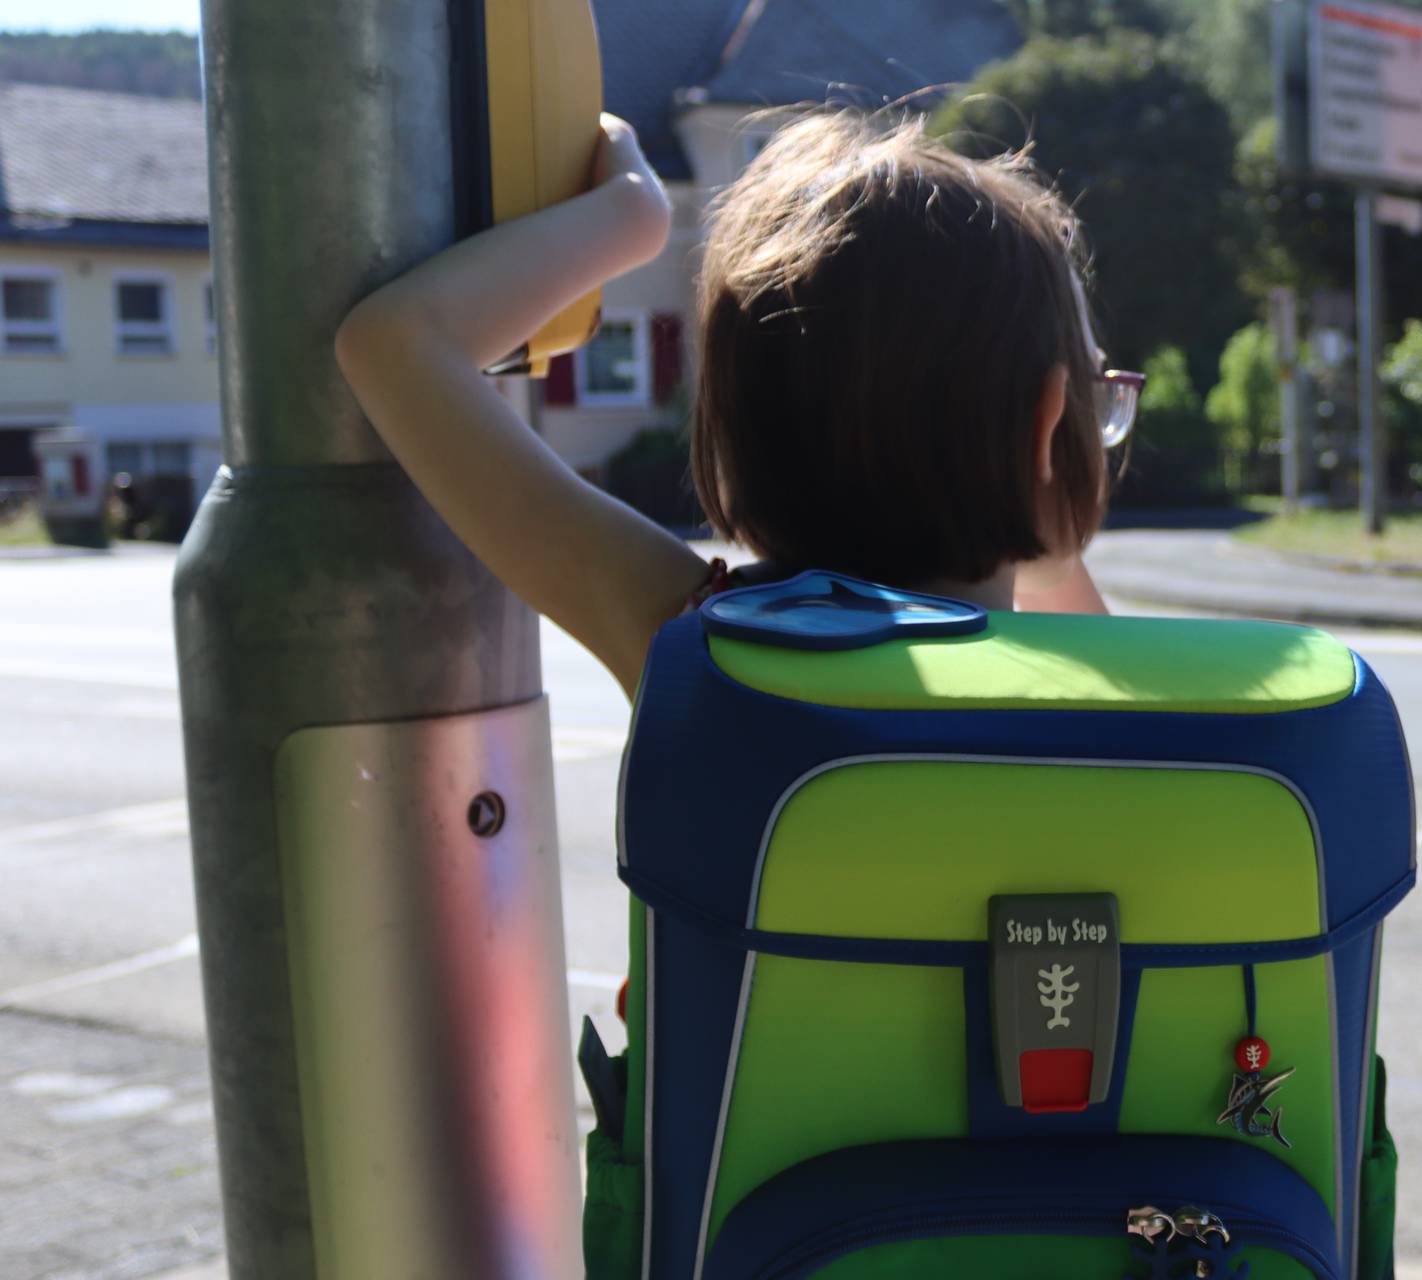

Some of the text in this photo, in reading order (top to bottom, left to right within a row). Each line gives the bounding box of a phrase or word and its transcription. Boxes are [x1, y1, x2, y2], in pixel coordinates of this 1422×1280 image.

[1007, 918, 1107, 945] Step by Step
